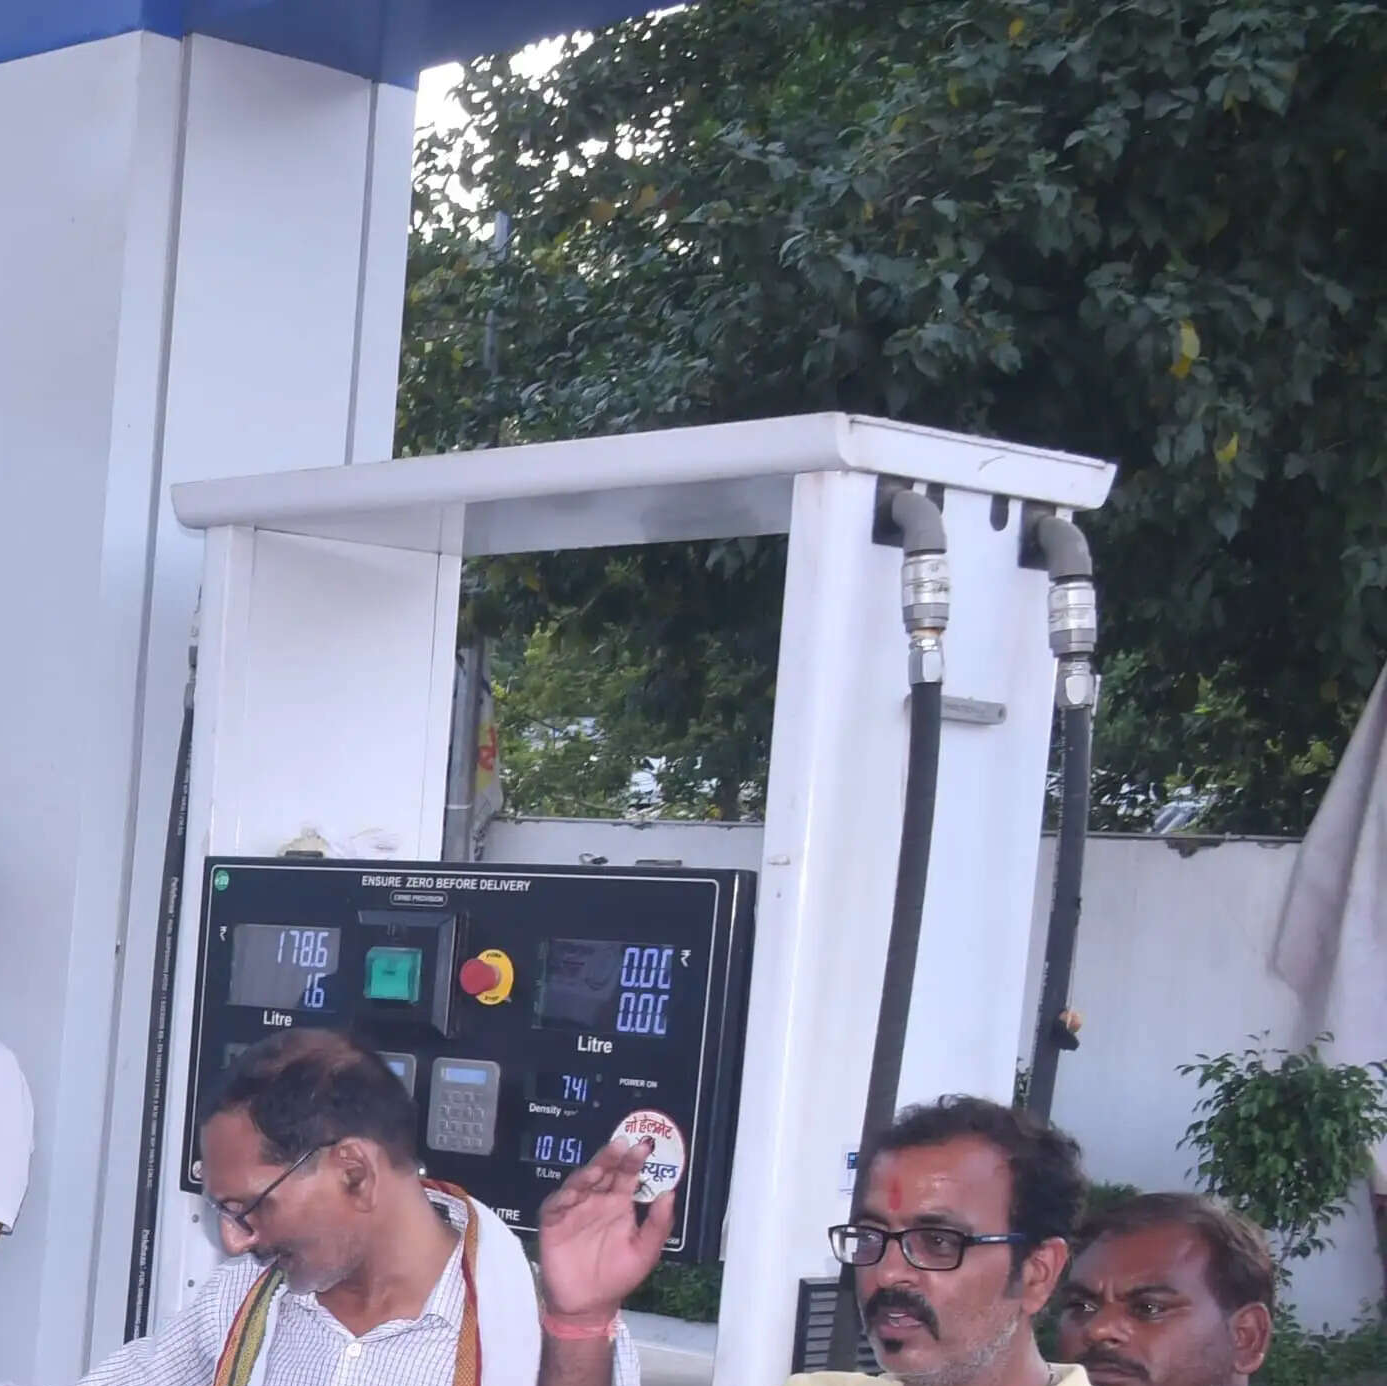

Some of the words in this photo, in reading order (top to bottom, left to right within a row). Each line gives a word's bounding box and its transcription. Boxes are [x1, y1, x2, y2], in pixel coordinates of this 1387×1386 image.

[362, 875, 401, 888] ENSURE
[406, 877, 433, 889] ZERO
[436, 877, 477, 890] BEFORE
[480, 879, 531, 891] DELIVERY
[263, 1010, 293, 1026] Litre
[577, 1035, 613, 1054] Litre
[562, 1075, 587, 1102] 741
[619, 1078, 645, 1087] POWER
[647, 1080, 658, 1088] ON
[529, 1103, 562, 1117] Density
[625, 1116, 638, 1134] नो
[639, 1114, 673, 1139] हेलमेट
